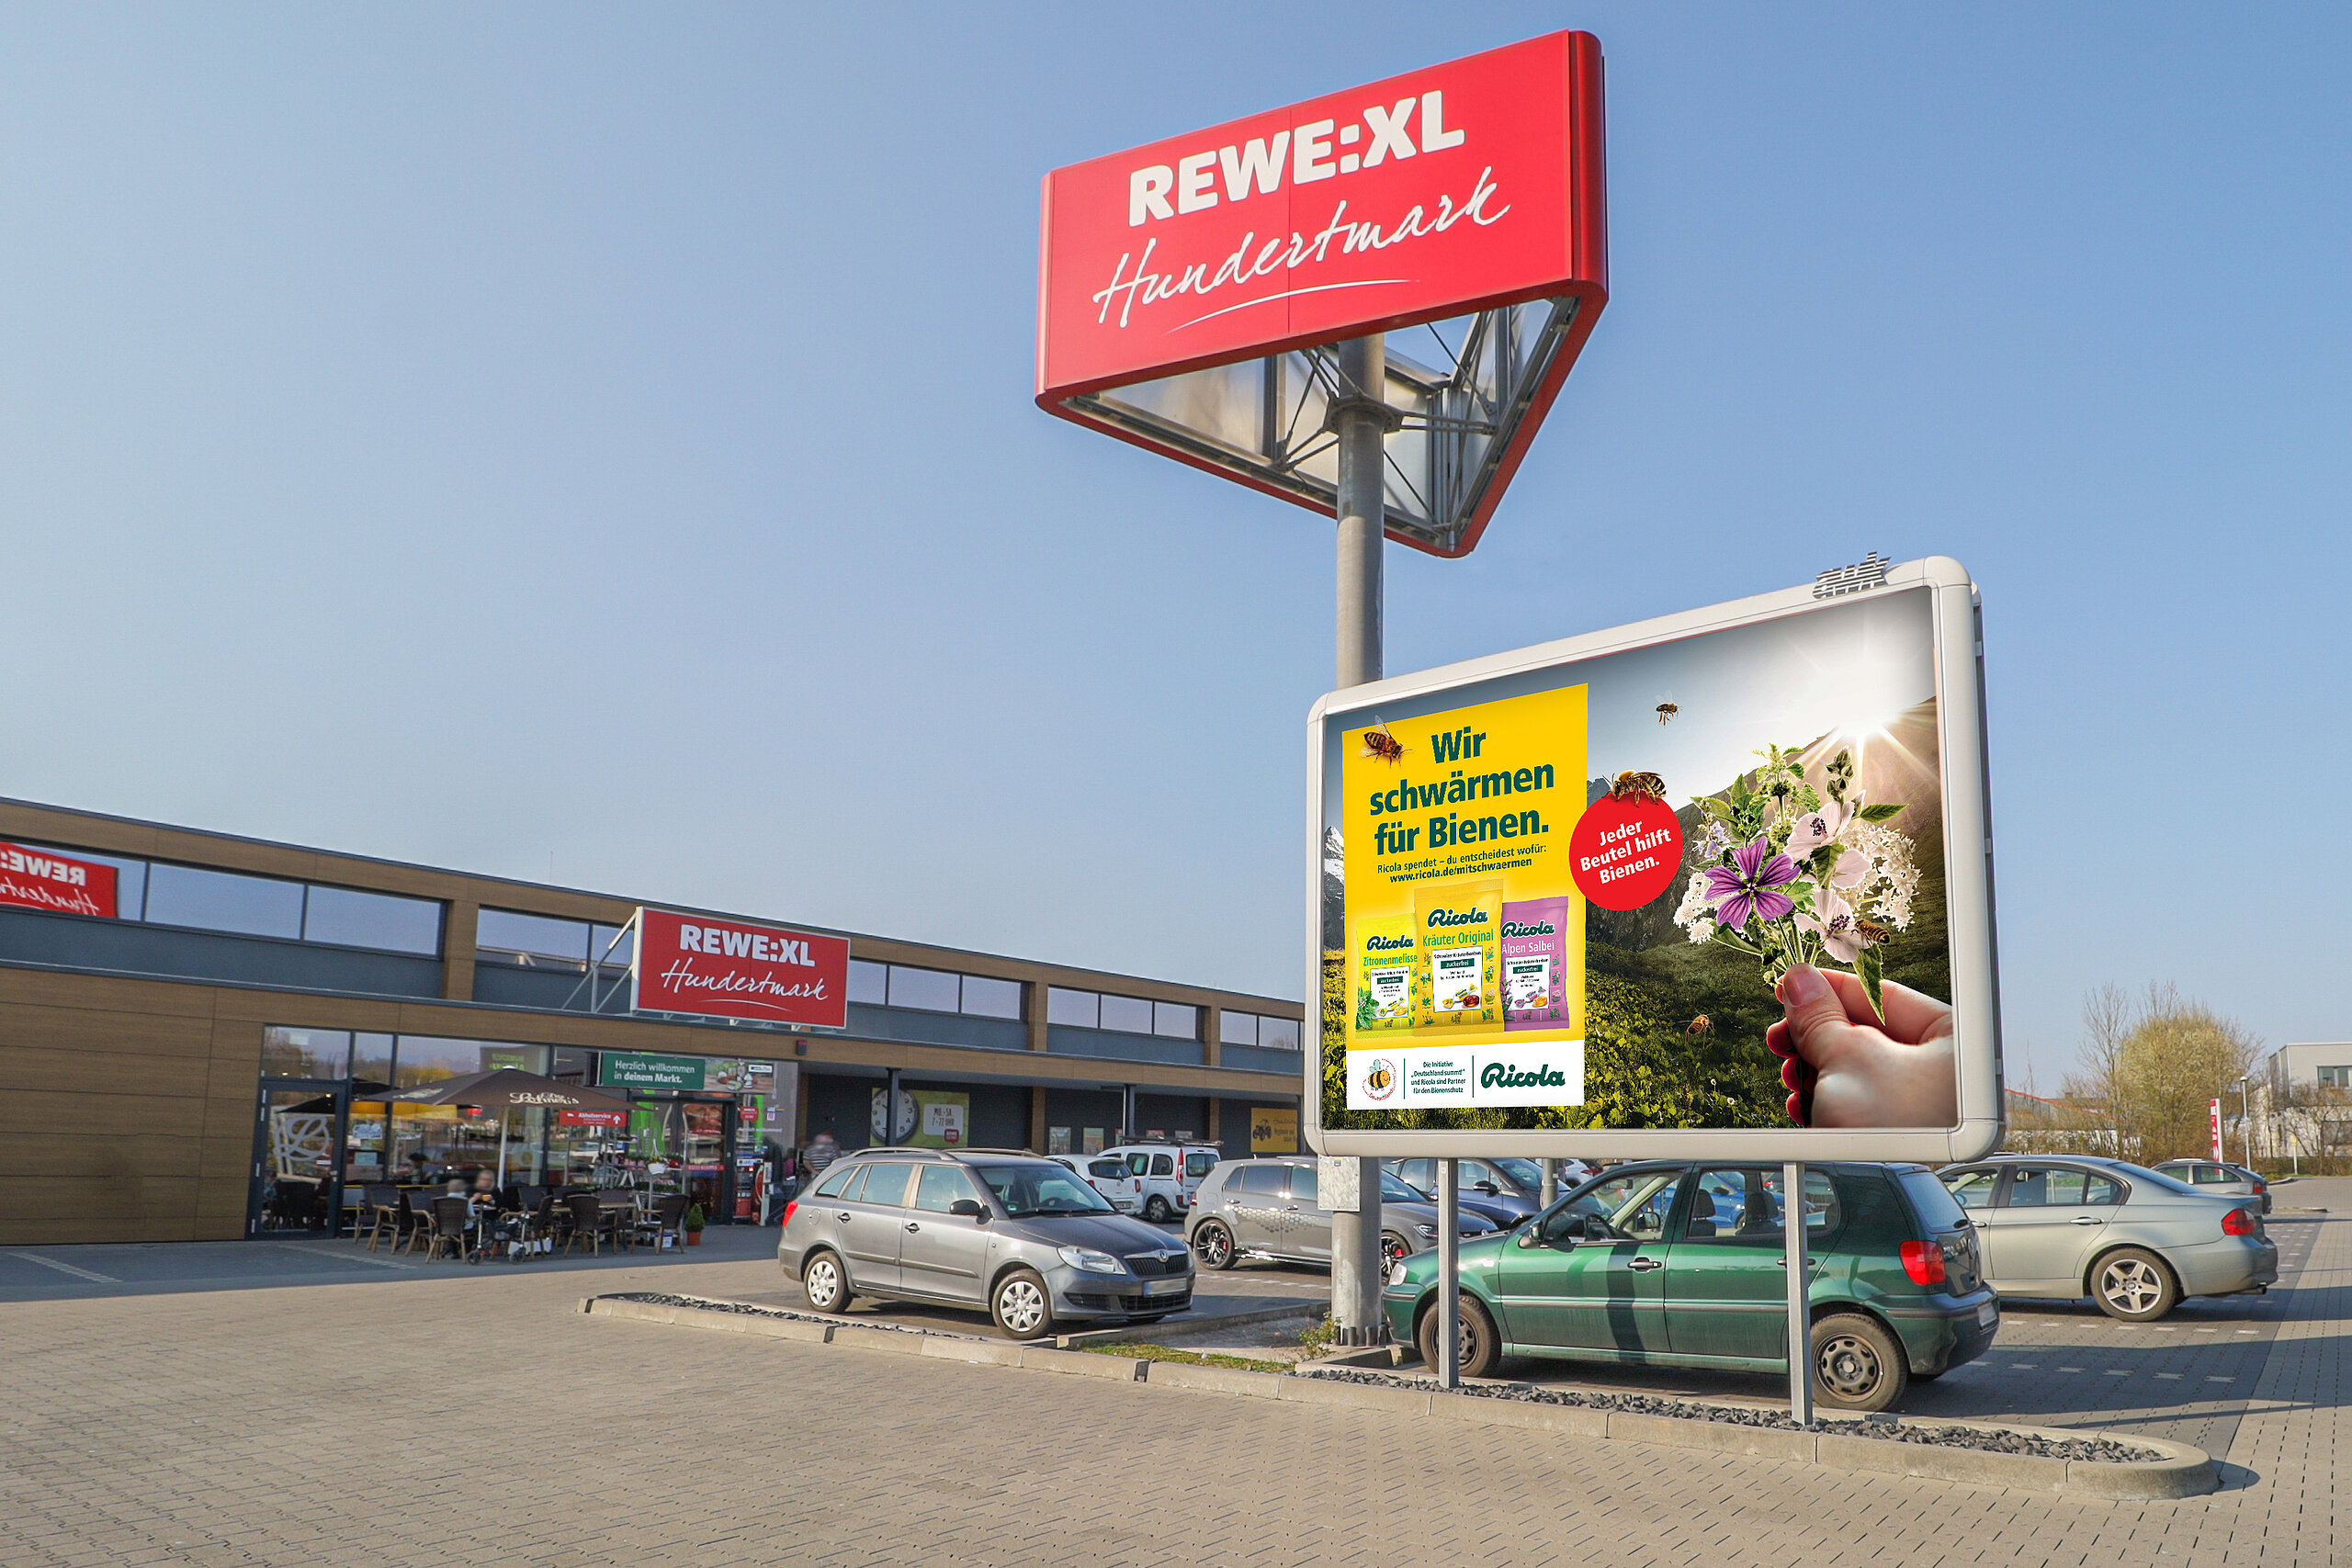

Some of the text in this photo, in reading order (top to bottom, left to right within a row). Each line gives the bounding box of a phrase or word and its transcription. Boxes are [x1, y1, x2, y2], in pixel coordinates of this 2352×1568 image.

[1128, 89, 1465, 228] REWE:XL
[1092, 166, 1511, 328] Hundertmark
[1430, 726, 1487, 764] Wir
[1370, 763, 1555, 816] schwärmen
[1374, 809, 1549, 856] für Bienen.
[1600, 820, 1643, 846] Jeder
[1377, 861, 1402, 874] Ricola
[1404, 857, 1437, 873] spendet
[1446, 855, 1457, 865] du
[1460, 847, 1515, 863] entscheidest
[1517, 843, 1547, 856] wofür:
[1580, 828, 1672, 872] Beutel hilft
[1389, 857, 1532, 883] www.ricola.de/mitschwaermen
[1599, 856, 1660, 885] Bienen.
[1427, 907, 1488, 928] Ricola
[1500, 919, 1555, 939] Ricola
[679, 924, 816, 967] REWE:XL
[1366, 934, 1415, 952] Ricola
[1422, 928, 1495, 948] Kräuter Original
[1501, 940, 1555, 955] Alpen Salbei
[1363, 954, 1418, 967] Zitronenmelisse
[661, 957, 829, 1000] Hundertmark
[614, 1071, 683, 1083] in deinem Markt.
[615, 1060, 695, 1074] Herzlich willkommen
[1481, 1063, 1566, 1089] Ricola
